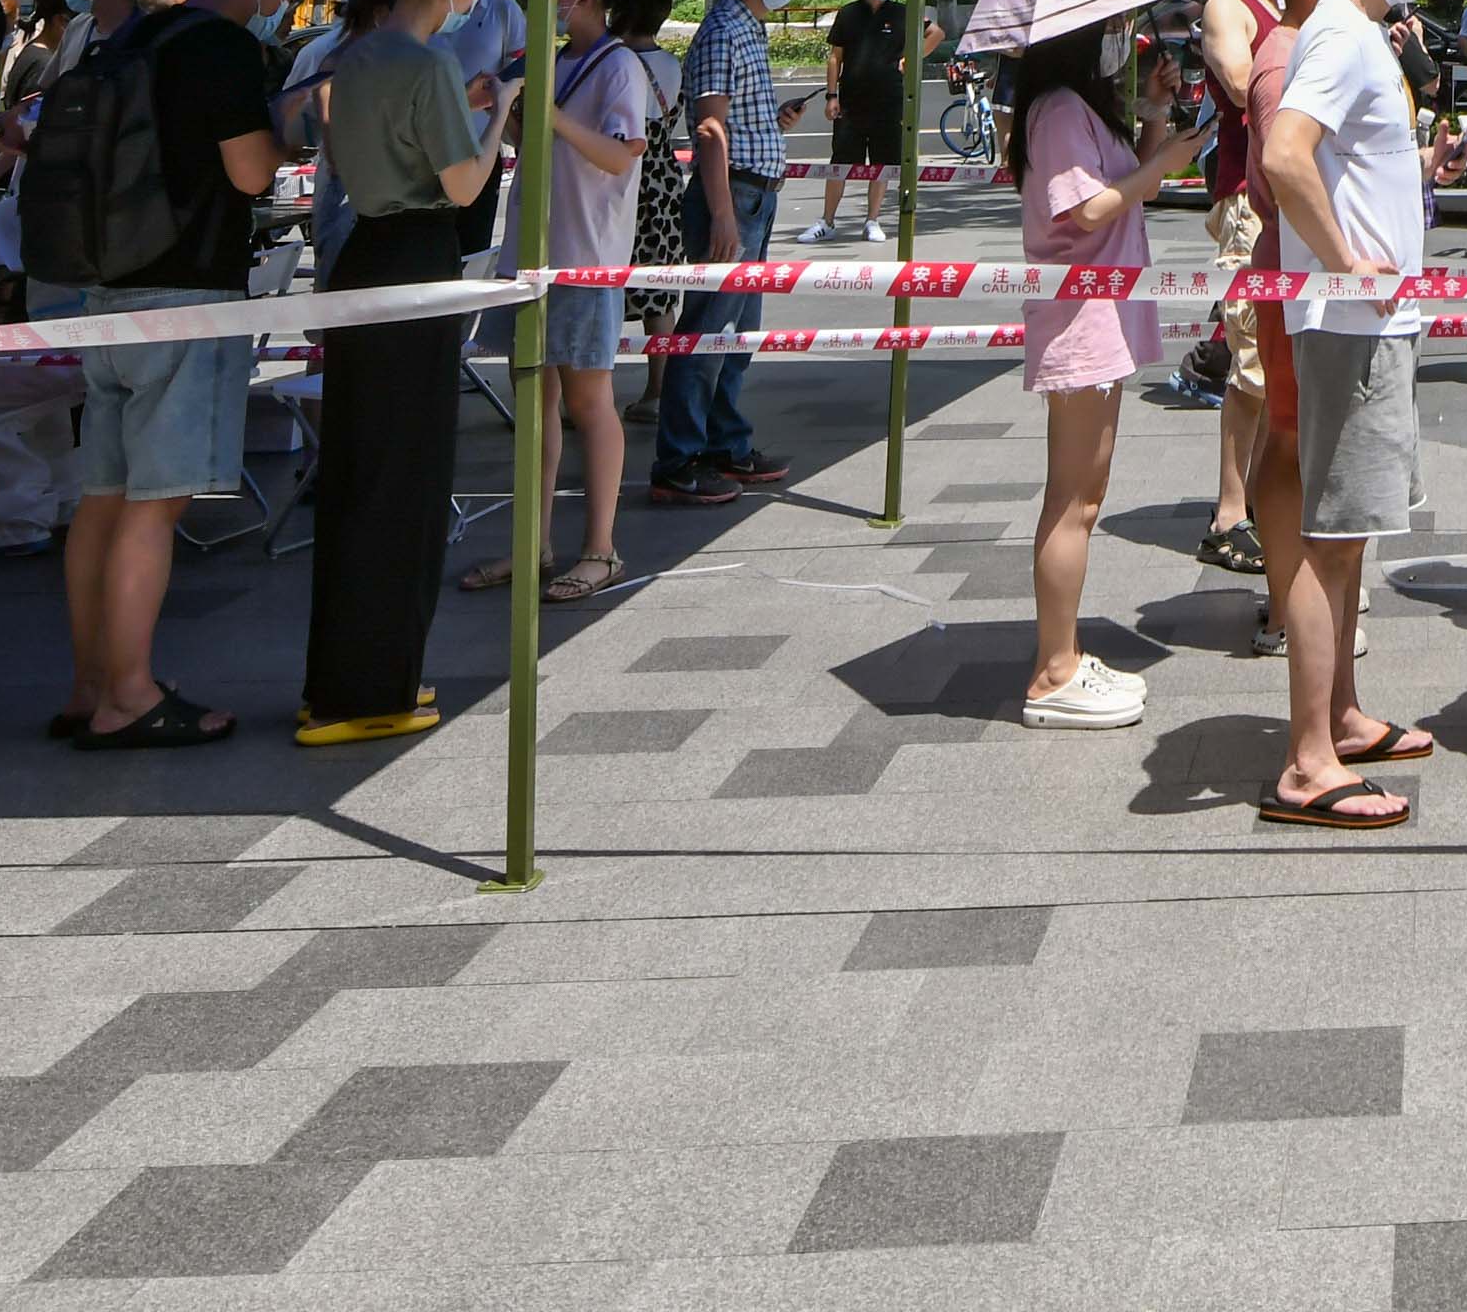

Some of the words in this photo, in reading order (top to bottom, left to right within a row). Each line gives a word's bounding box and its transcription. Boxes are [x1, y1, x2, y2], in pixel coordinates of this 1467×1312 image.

[567, 267, 624, 283] SAFE
[746, 264, 793, 279] 安全
[826, 265, 874, 281] 注意
[912, 264, 959, 283] 安全
[993, 267, 1042, 284] 注意
[1079, 269, 1126, 286] 安全
[647, 273, 706, 286] CAUTION
[734, 276, 785, 289] SAFE
[814, 279, 874, 291] CAUTION
[1160, 271, 1210, 287] 注意
[1246, 273, 1293, 290] 安全
[1327, 276, 1378, 291] 注意
[902, 281, 953, 293] SAFE
[982, 283, 1042, 295] CAUTION
[1070, 284, 1121, 296] SAFE
[1150, 285, 1210, 296] CAUTION
[1415, 278, 1461, 293] 安全
[1238, 287, 1289, 297] SAFE
[1318, 287, 1378, 297] CAUTION
[773, 332, 806, 345] 安全
[889, 329, 922, 341] 安全
[996, 336, 1024, 346] SAF
[1162, 331, 1203, 339] CAUTION
[657, 336, 690, 349] 安全
[706, 343, 748, 352] CAUTION
[767, 343, 803, 352] SAFE
[822, 340, 864, 349] CAUTION
[882, 339, 918, 348] SAFE
[937, 337, 979, 346] CAUTION
[651, 346, 687, 354] SAFE
